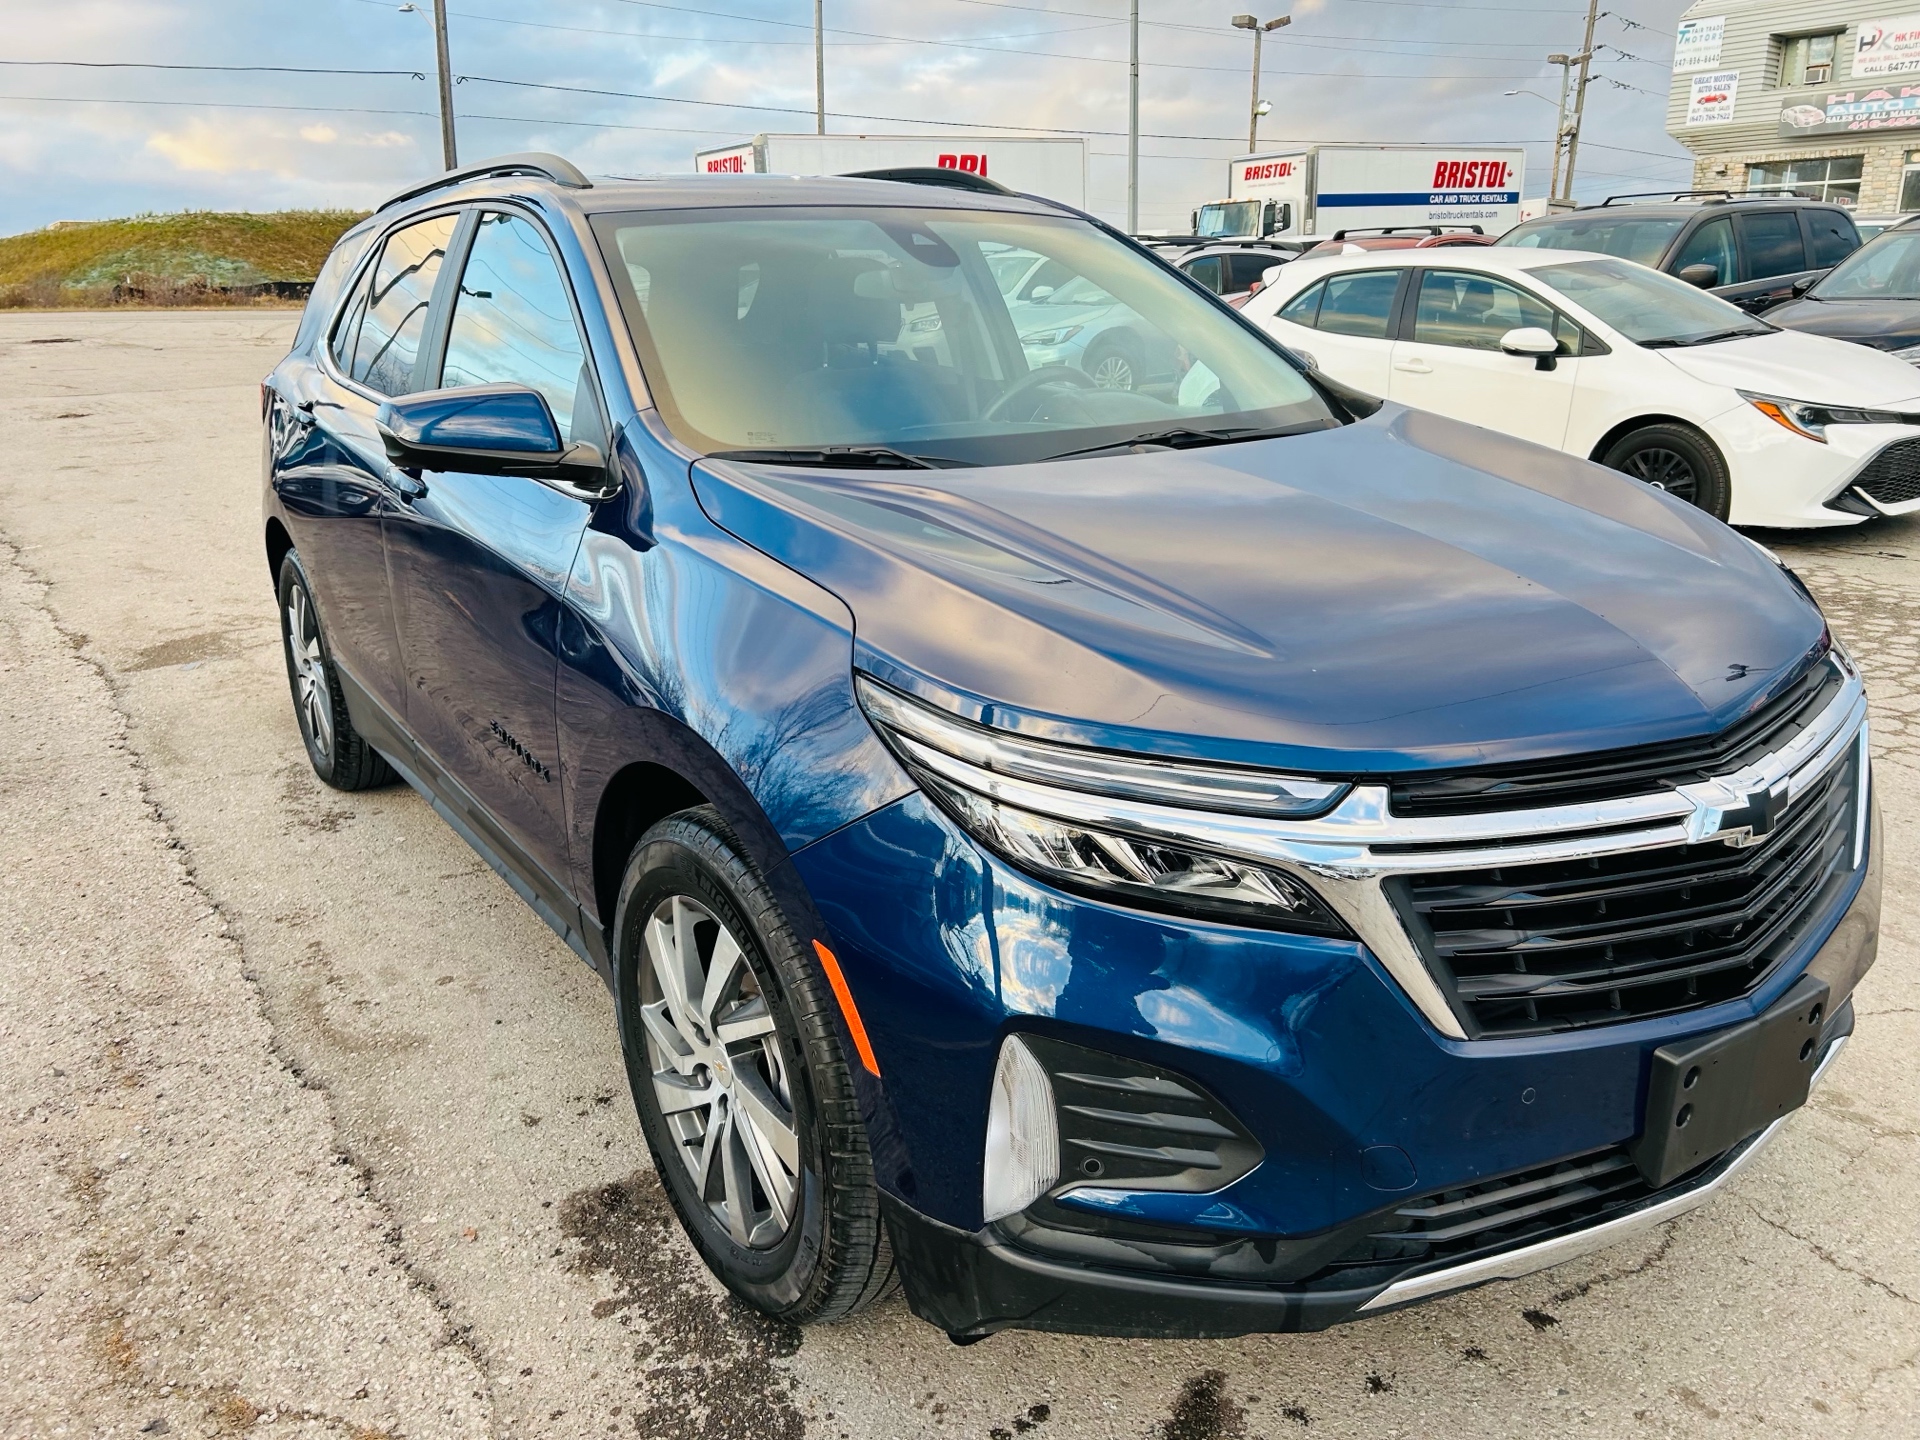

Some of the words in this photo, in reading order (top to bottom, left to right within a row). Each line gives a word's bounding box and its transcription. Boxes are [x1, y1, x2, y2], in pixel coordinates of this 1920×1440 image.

[1684, 32, 1723, 44] MOTORS
[1895, 32, 1907, 42] HK
[1864, 65, 1886, 73] CALL:
[1694, 76, 1712, 85] GREAT
[1713, 73, 1737, 83] MOTORS
[1698, 85, 1712, 93] AUTO
[1713, 83, 1731, 91] SALES
[1829, 99, 1905, 116] AUTO
[1825, 114, 1853, 124] SALES
[1855, 113, 1869, 121] OF
[1870, 111, 1888, 119] ALL
[1244, 162, 1292, 181] BRISTOL
[1433, 161, 1507, 188] BRISTOL
[1429, 195, 1444, 203] CAR
[1444, 195, 1458, 203] AND
[1459, 194, 1480, 203] TRUCK
[1481, 194, 1508, 202] RENTALS
[1428, 210, 1498, 220] bristoltruckrentals.com
[699, 875, 763, 971] MICHELIN
